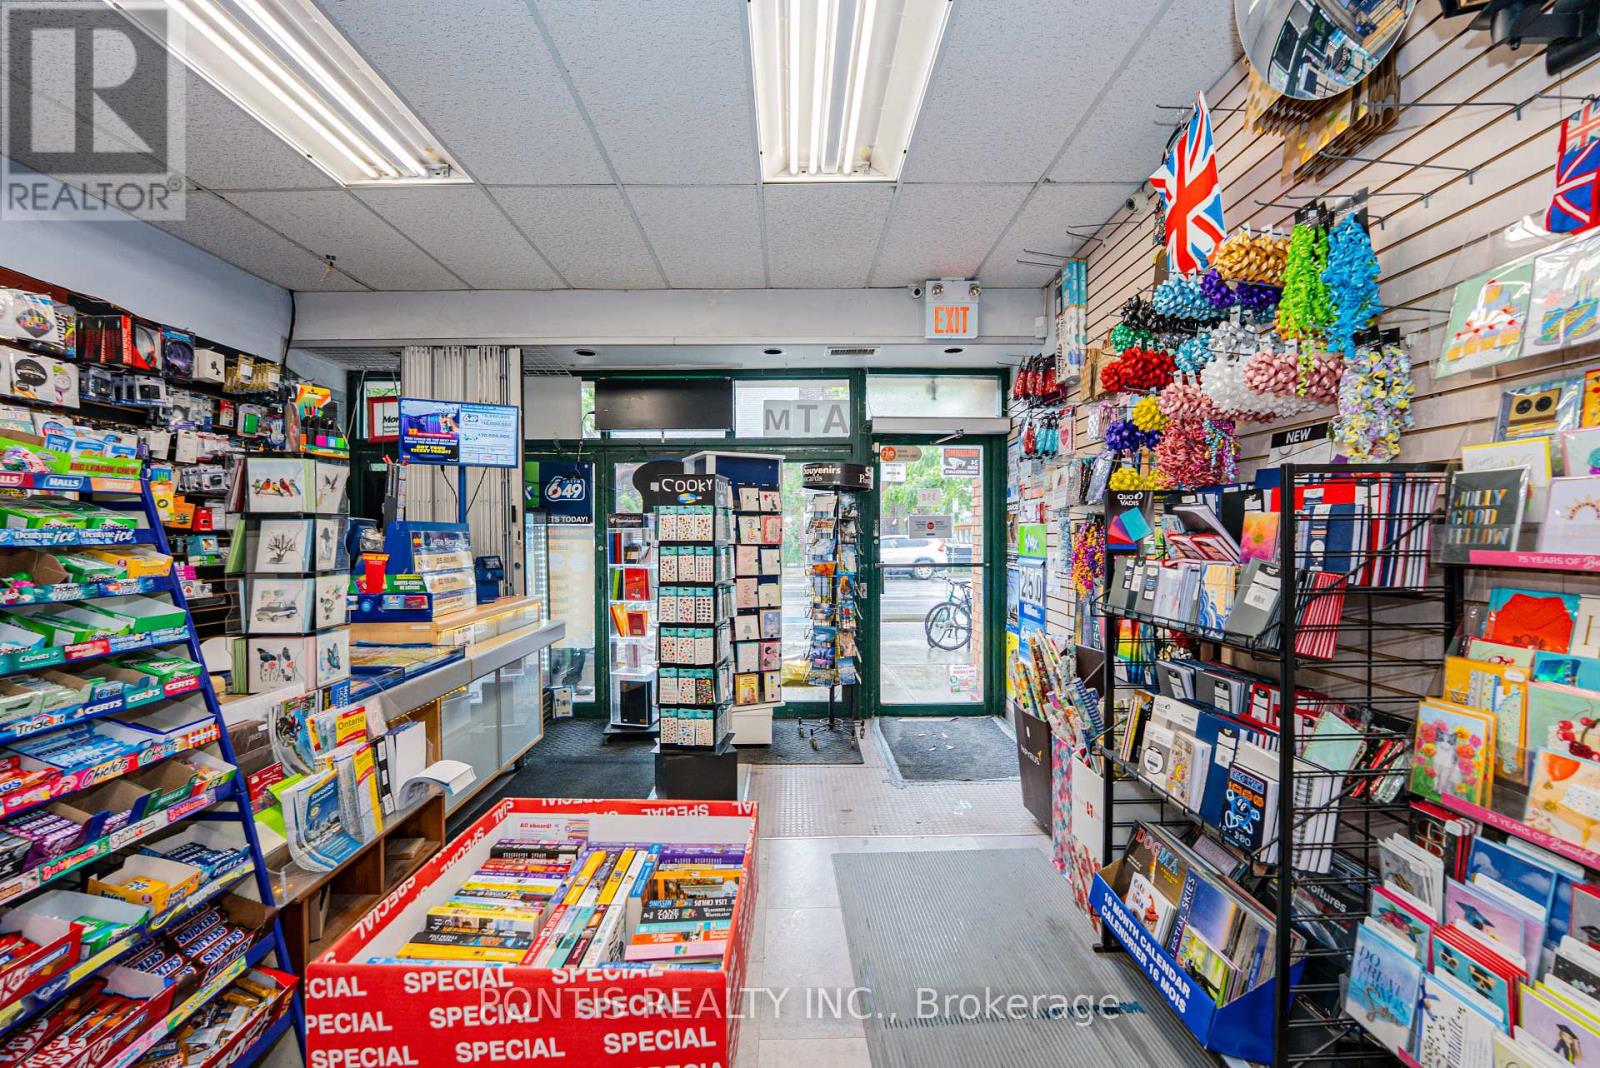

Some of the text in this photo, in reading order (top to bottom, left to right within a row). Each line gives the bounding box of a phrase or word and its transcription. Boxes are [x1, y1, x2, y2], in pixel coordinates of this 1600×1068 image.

[933, 306, 970, 334] EXIT
[1285, 428, 1312, 443] NEW
[48, 477, 80, 488] HALLS
[561, 515, 588, 523] TODAY!
[1451, 508, 1498, 527] GOOD
[54, 530, 76, 543] ice
[114, 530, 134, 543] ice
[1447, 527, 1510, 545] FELLOW
[1531, 555, 1564, 565] YEARS
[1566, 557, 1580, 566] OF
[83, 699, 124, 715] CERTS
[164, 677, 197, 691] CERTS
[338, 715, 365, 730] Ontario
[82, 758, 130, 788] Chiclets
[640, 804, 710, 817] SPECIAL
[1500, 819, 1531, 837] YEARS
[1182, 876, 1197, 911] SKIES
[176, 912, 219, 945] SNICKERS
[202, 931, 246, 965] SNICKERS
[1103, 892, 1191, 999] 16 MONTH CALENDAR
[1100, 904, 1187, 1014] CALENDRIER 16 MOIS
[303, 967, 662, 999] ECIAL SPECIAL SPECIAL
[304, 1010, 393, 1036] PECIAL
[429, 1001, 539, 1029] SPECIAL
[577, 992, 691, 1019] SPECIAL
[311, 1027, 716, 1068] SPECIAL SPECIAL SPECIAL
